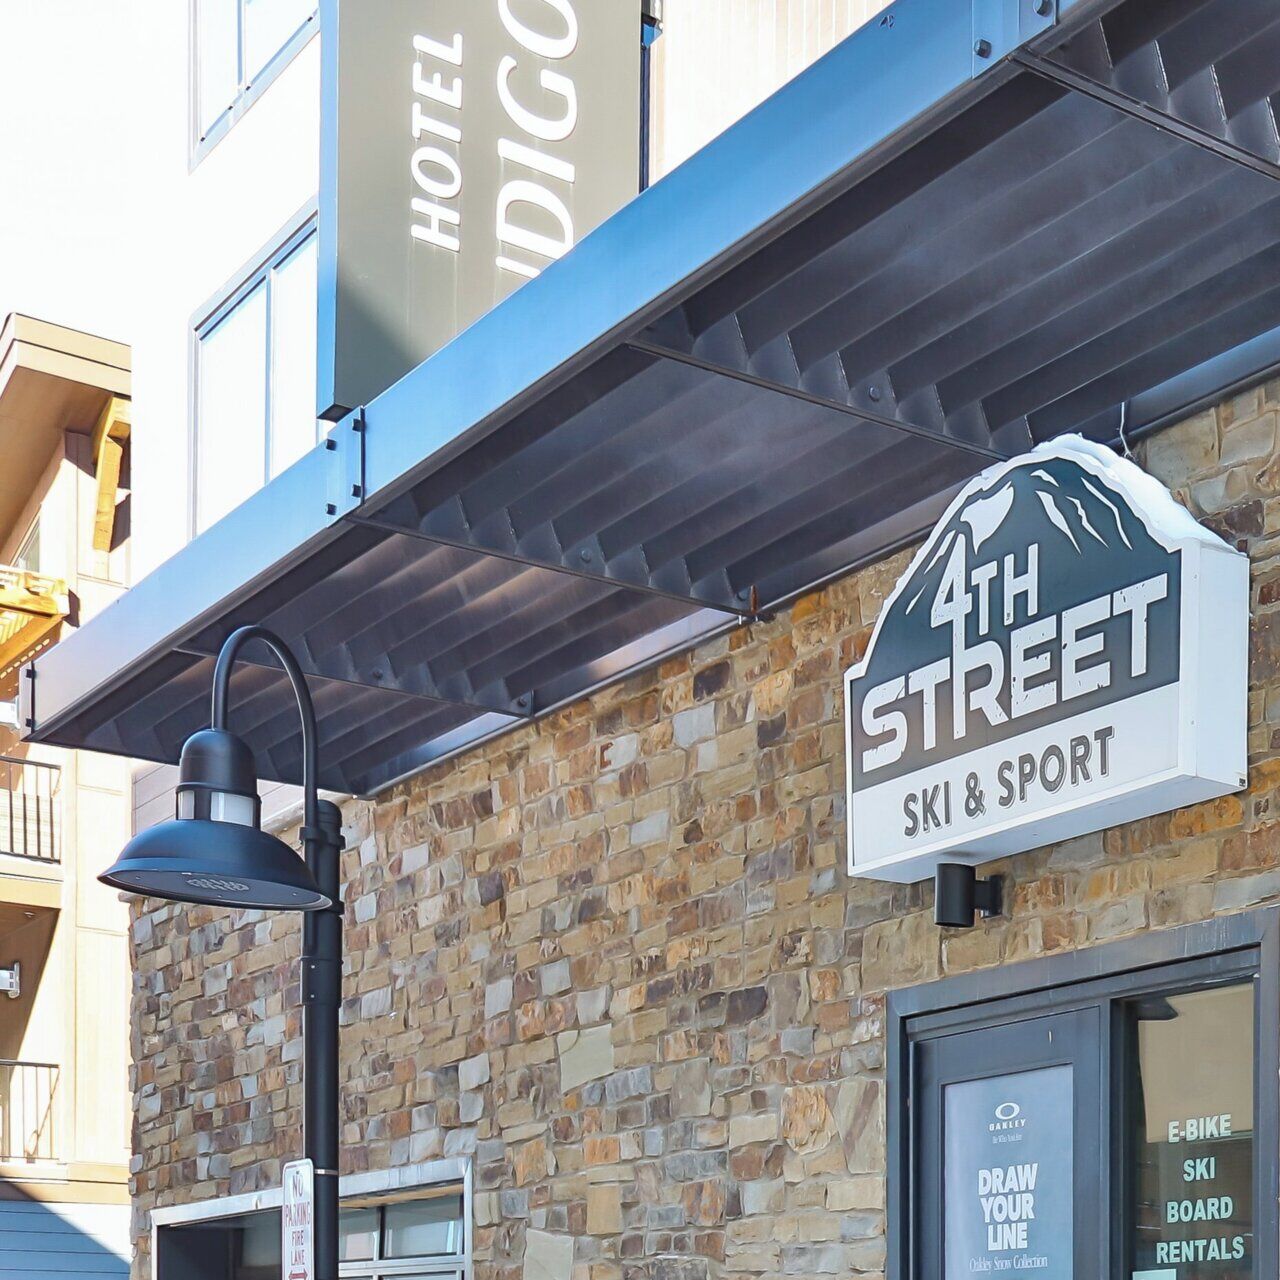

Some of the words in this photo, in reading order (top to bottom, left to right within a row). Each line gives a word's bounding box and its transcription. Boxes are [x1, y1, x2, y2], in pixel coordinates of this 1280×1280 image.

[410, 33, 463, 253] HOTEL
[930, 532, 1039, 637] 4TH
[861, 572, 1168, 774] STREET
[903, 778, 950, 839] SKI
[963, 770, 988, 818] &
[997, 725, 1115, 808] SPORT
[989, 1119, 1026, 1131] OAKLEY
[1168, 1113, 1232, 1144] E-BIKE
[978, 1163, 1038, 1195] DRAW
[1182, 1156, 1216, 1182] SKI
[292, 1174, 304, 1197] NO
[284, 1201, 311, 1228] PARKING
[980, 1193, 1035, 1222] YOUR
[1166, 1195, 1234, 1224] BOARD
[291, 1230, 305, 1247] FIRE
[987, 1222, 1028, 1251] LINE
[1156, 1235, 1245, 1265] RENTALS
[290, 1250, 305, 1266] LANE
